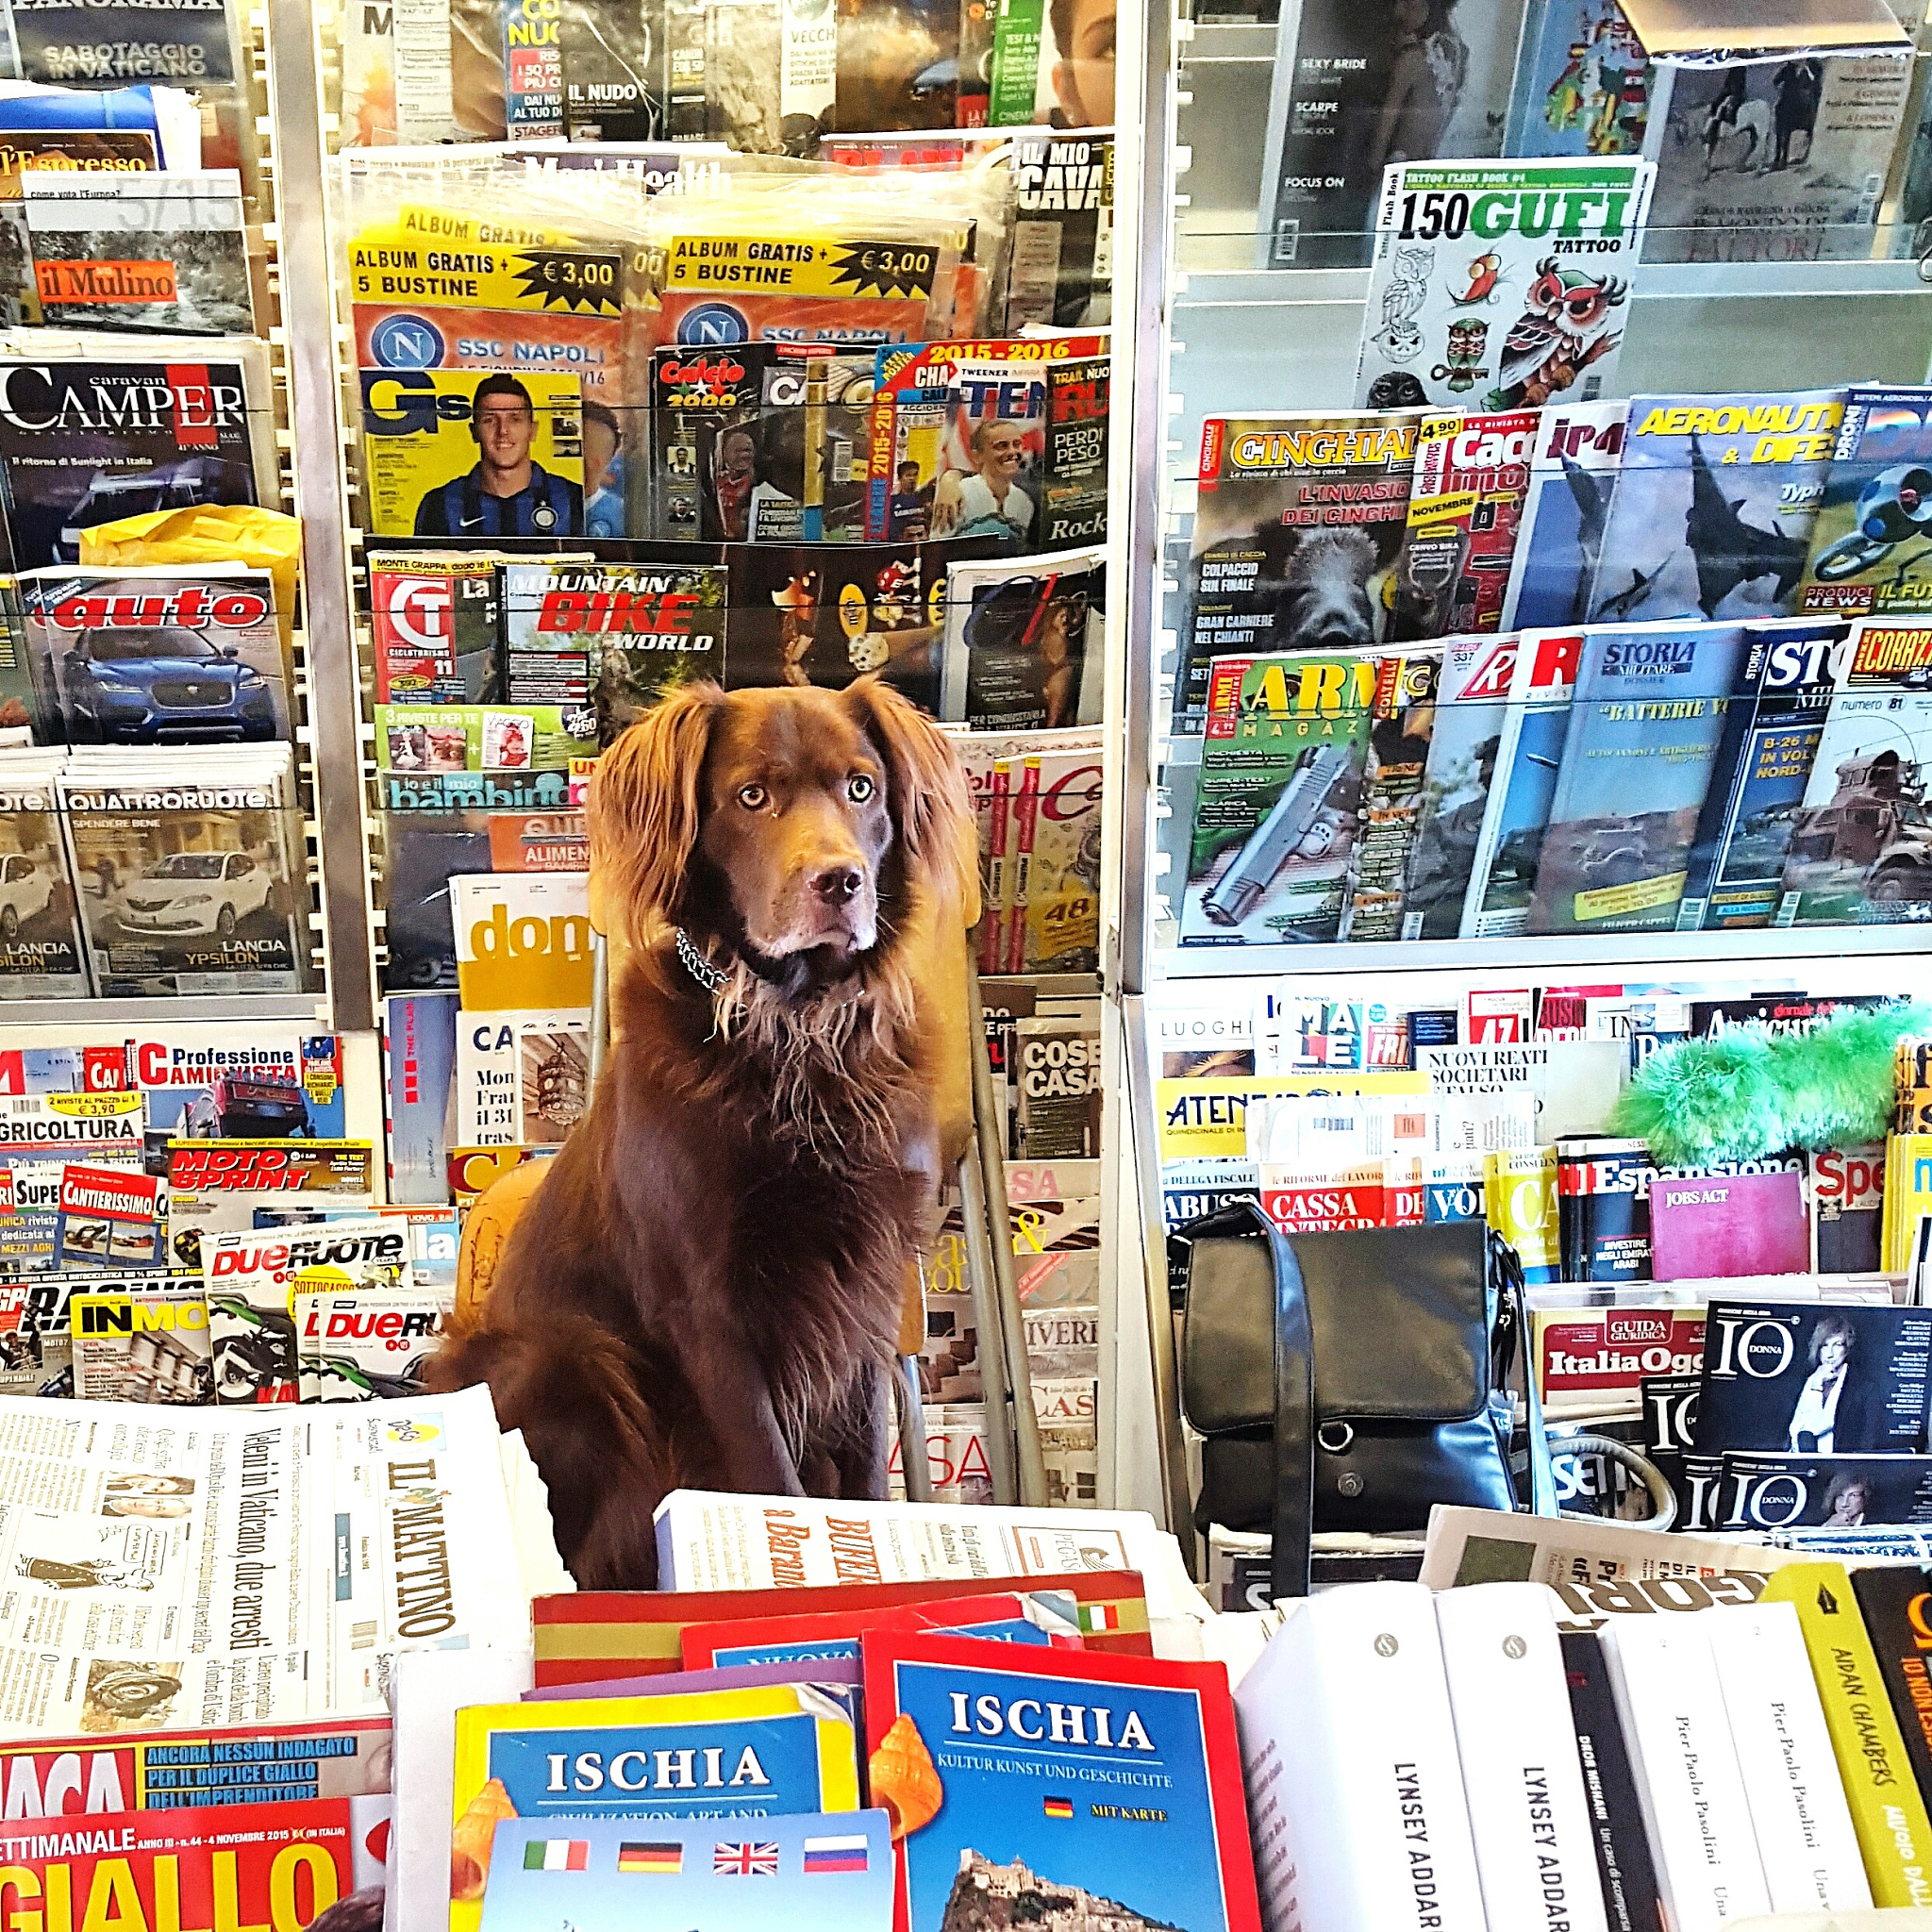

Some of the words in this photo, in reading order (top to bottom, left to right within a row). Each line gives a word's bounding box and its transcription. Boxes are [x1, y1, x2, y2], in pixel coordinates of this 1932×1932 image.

[45, 42, 205, 62] SABOTAGGIO
[49, 62, 74, 78] IN
[73, 58, 207, 77] VATICANO
[1333, 58, 1367, 70] BRIDE
[569, 86, 584, 102] IL
[589, 85, 638, 102] NUDO
[1295, 101, 1339, 113] SCARPE
[1022, 142, 1042, 165] IL
[1049, 142, 1090, 165] MIO
[1284, 176, 1322, 189] FOCUS
[1324, 176, 1345, 189] ON
[1388, 172, 1400, 199] Book
[407, 211, 468, 239] ALBUM
[1397, 192, 1470, 241] 150
[1469, 192, 1631, 240] GUFI
[675, 240, 738, 262] ALBUM
[748, 243, 813, 261] GRATIS
[1553, 240, 1622, 254] TATTOO
[355, 250, 417, 270] ALBUM
[427, 251, 494, 274] GRATIS
[880, 251, 930, 277] 3,00
[42, 267, 62, 297] il
[69, 266, 174, 298] Mulino
[562, 261, 613, 286] 3,00
[675, 263, 686, 280] 5
[697, 265, 792, 284] BUSTINE
[358, 275, 371, 292] 5
[382, 276, 478, 297] BUSTINE
[392, 331, 431, 364] N
[458, 338, 504, 358] SSC
[513, 341, 605, 364] NAPOLI
[89, 376, 167, 388] caravan
[660, 358, 745, 385] Calcio
[961, 368, 1009, 378] TWEENER
[1053, 373, 1084, 386] TRAIL
[0, 366, 246, 431] CAMPER
[666, 394, 737, 411] 2000
[872, 391, 894, 475] 2015-2016
[1054, 426, 1104, 450] PERDI
[1056, 442, 1101, 463] PESO
[1723, 448, 1739, 464] &
[70, 457, 113, 470] Sunlight
[125, 457, 153, 467] Italia
[1282, 508, 1319, 525] DEI
[1411, 496, 1474, 519] NOVEMBRE
[376, 558, 408, 570] MONTE
[509, 574, 672, 594] MOUNTAIN
[1220, 576, 1256, 592] FINALE
[1807, 585, 1874, 599] PRODUCT
[1879, 585, 1894, 600] IL
[51, 585, 269, 632] auto
[1804, 597, 1873, 608] NEWS
[536, 592, 700, 635] BIKE
[1196, 615, 1224, 629] GRAN
[613, 632, 715, 652] WORLD
[1602, 640, 1698, 665] STORIA
[433, 659, 452, 675] 11
[1453, 651, 1475, 663] 337
[1744, 643, 1765, 680] STORIA
[1840, 699, 1883, 713] numero
[1890, 697, 1904, 710] 81
[385, 708, 396, 723] 3
[440, 713, 461, 724] PER
[464, 713, 479, 724] TE
[403, 778, 419, 791] io
[448, 777, 478, 790] mio
[132, 818, 161, 829] BENE
[7, 941, 72, 956] LANCIA
[223, 940, 287, 953] LANCIA
[185, 952, 260, 967] YPSILON
[1160, 1020, 1254, 1037] LUOGHI
[172, 1048, 294, 1066] Professione
[1429, 1052, 1488, 1069] NUOVI
[1492, 1049, 1549, 1067] REATI
[1025, 1067, 1102, 1098] CASA
[1431, 1067, 1528, 1085] SOCIETARI
[91, 1104, 115, 1117] 3,90
[172, 1148, 288, 1172] MOTO
[169, 1169, 310, 1191] SPRINT
[1171, 1174, 1211, 1186] DELEGA
[1213, 1173, 1256, 1185] FISCALE
[1283, 1173, 1331, 1185] RIFORME
[62, 1180, 154, 1216] CANTIERISSIMO
[1273, 1194, 1358, 1219] CASSA
[1665, 1190, 1701, 1208] JOBS
[1701, 1189, 1729, 1205] ACT
[28, 1215, 58, 1225] rivista
[1, 1230, 43, 1241] dedicata
[1604, 1239, 1648, 1251] INVESTIRE
[1, 1243, 29, 1255] MEZZI
[1596, 1248, 1623, 1260] NEGLI
[1612, 1258, 1640, 1270] ARABI
[1610, 1320, 1667, 1334] GUIDA
[1610, 1330, 1667, 1341] GIURIDICA
[1710, 1319, 1794, 1379] IO
[1749, 1344, 1783, 1356] DONNA
[242, 1427, 282, 1468] Veleni
[242, 1461, 279, 1488] in
[388, 1458, 437, 1491] IL
[1723, 1473, 1808, 1530] IO
[1761, 1495, 1795, 1507] DONNA
[227, 1488, 280, 1558] Vaticano,
[233, 1559, 277, 1591] due
[392, 1501, 457, 1639] MATTINO
[229, 1594, 274, 1651] arresti
[948, 1690, 1157, 1754] ISCHIA
[1830, 1647, 1868, 1698] AIDAN
[1849, 1703, 1898, 1788] CHAMBERS
[1675, 1715, 1690, 1749] Pier
[147, 1744, 210, 1766] ANCORA
[214, 1741, 275, 1763] NESSUN
[277, 1737, 356, 1760] INDAGATO
[1577, 1734, 1596, 1769] DROR
[147, 1767, 177, 1788] PER
[180, 1766, 195, 1786] IL
[197, 1762, 261, 1786] DUPLICE
[264, 1760, 317, 1783] GIALLO
[546, 1743, 771, 1794] ISCHIA
[937, 1753, 994, 1772] KULTUR
[996, 1757, 1042, 1778] KUNST
[1044, 1762, 1078, 1782] UND
[1078, 1767, 1174, 1790] GESCHICHTE
[1684, 1753, 1705, 1796] Paolo
[1393, 1762, 1429, 1843] LYNSEY
[1586, 1767, 1609, 1821] MISHANI
[1771, 1701, 1787, 1735] Pier
[1780, 1737, 1801, 1781] Paolo
[1792, 1784, 1821, 1849] Pasolini
[1812, 1868, 1830, 1902] Una
[1091, 1803, 1120, 1821] MIT
[1120, 1806, 1168, 1824] KARTE
[1522, 1766, 1557, 1848] LYNSEY
[215, 1832, 266, 1846] NOVEMBRE
[267, 1829, 290, 1843] 2015
[1599, 1827, 1611, 1843] Un
[1693, 1799, 1722, 1866] Pasolini
[1602, 1843, 1617, 1869] caso
[0, 1841, 340, 1932] GIALLO
[1612, 1878, 1633, 1932] scomparsa
[1713, 1886, 1729, 1917] Una
